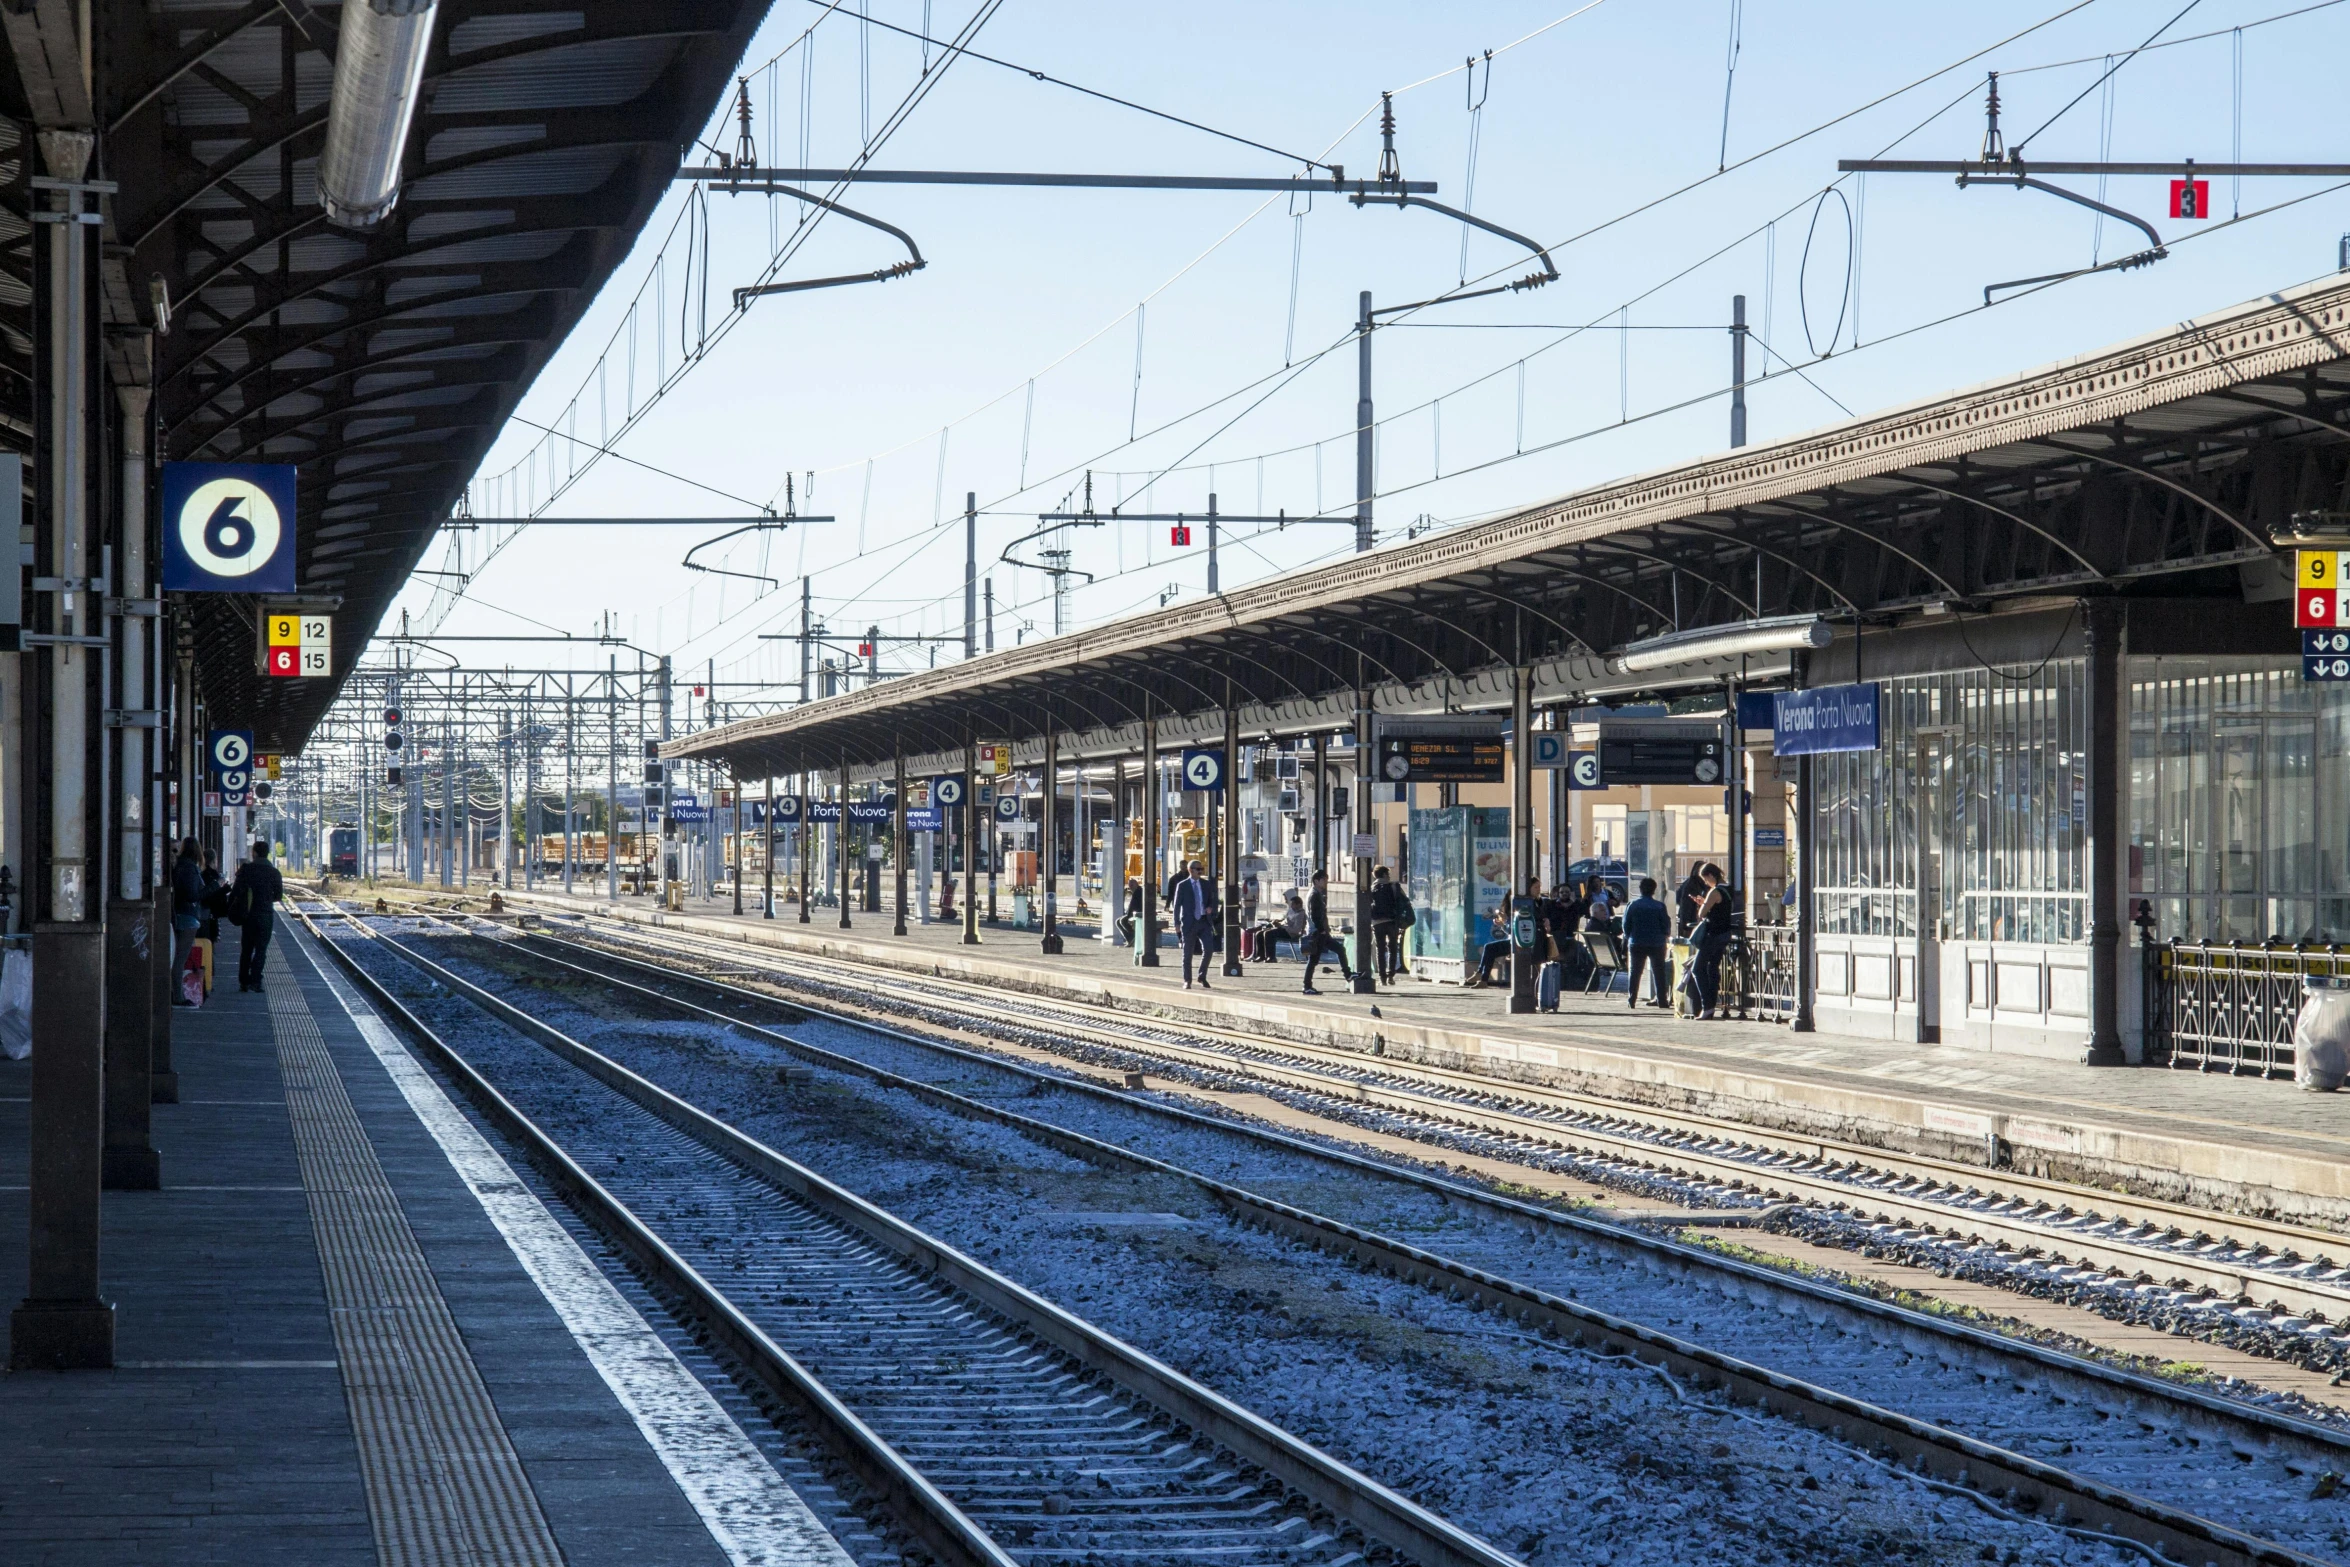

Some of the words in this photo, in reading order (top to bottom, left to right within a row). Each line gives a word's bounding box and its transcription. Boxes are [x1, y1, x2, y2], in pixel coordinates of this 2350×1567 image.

[2181, 189, 2196, 218] 3
[203, 496, 255, 559] 6
[1177, 530, 1184, 546] 3
[2311, 559, 2325, 579] 9
[2343, 561, 2350, 580] 1
[2309, 596, 2325, 618] 6
[2343, 598, 2350, 618] 1
[278, 621, 290, 638] 9
[305, 622, 325, 638] 12
[277, 651, 291, 669] 6
[305, 653, 325, 669] 15
[1777, 700, 1815, 733] Verona
[1816, 696, 1839, 729] Porta
[1840, 692, 1872, 727] Nuova
[223, 741, 240, 761] 6
[985, 749, 991, 758] 9
[997, 750, 1006, 758] 12
[1390, 741, 1398, 752] 4
[1540, 738, 1559, 760] D
[1706, 744, 1714, 755] 3
[667, 760, 681, 769] 100
[997, 763, 1006, 771] 15
[1193, 761, 1209, 780] 4
[1581, 761, 1596, 780] 3
[228, 771, 239, 786] 6
[271, 770, 279, 778] 15
[942, 784, 954, 799] 4
[981, 788, 990, 802] E
[782, 801, 792, 812] 4
[814, 804, 841, 817] Porta
[848, 804, 887, 817] Nuova
[1003, 800, 1013, 813] 3
[1476, 841, 1487, 850] TU
[1294, 858, 1309, 868] 217
[1294, 868, 1309, 878] 260
[1294, 878, 1309, 888] 100
